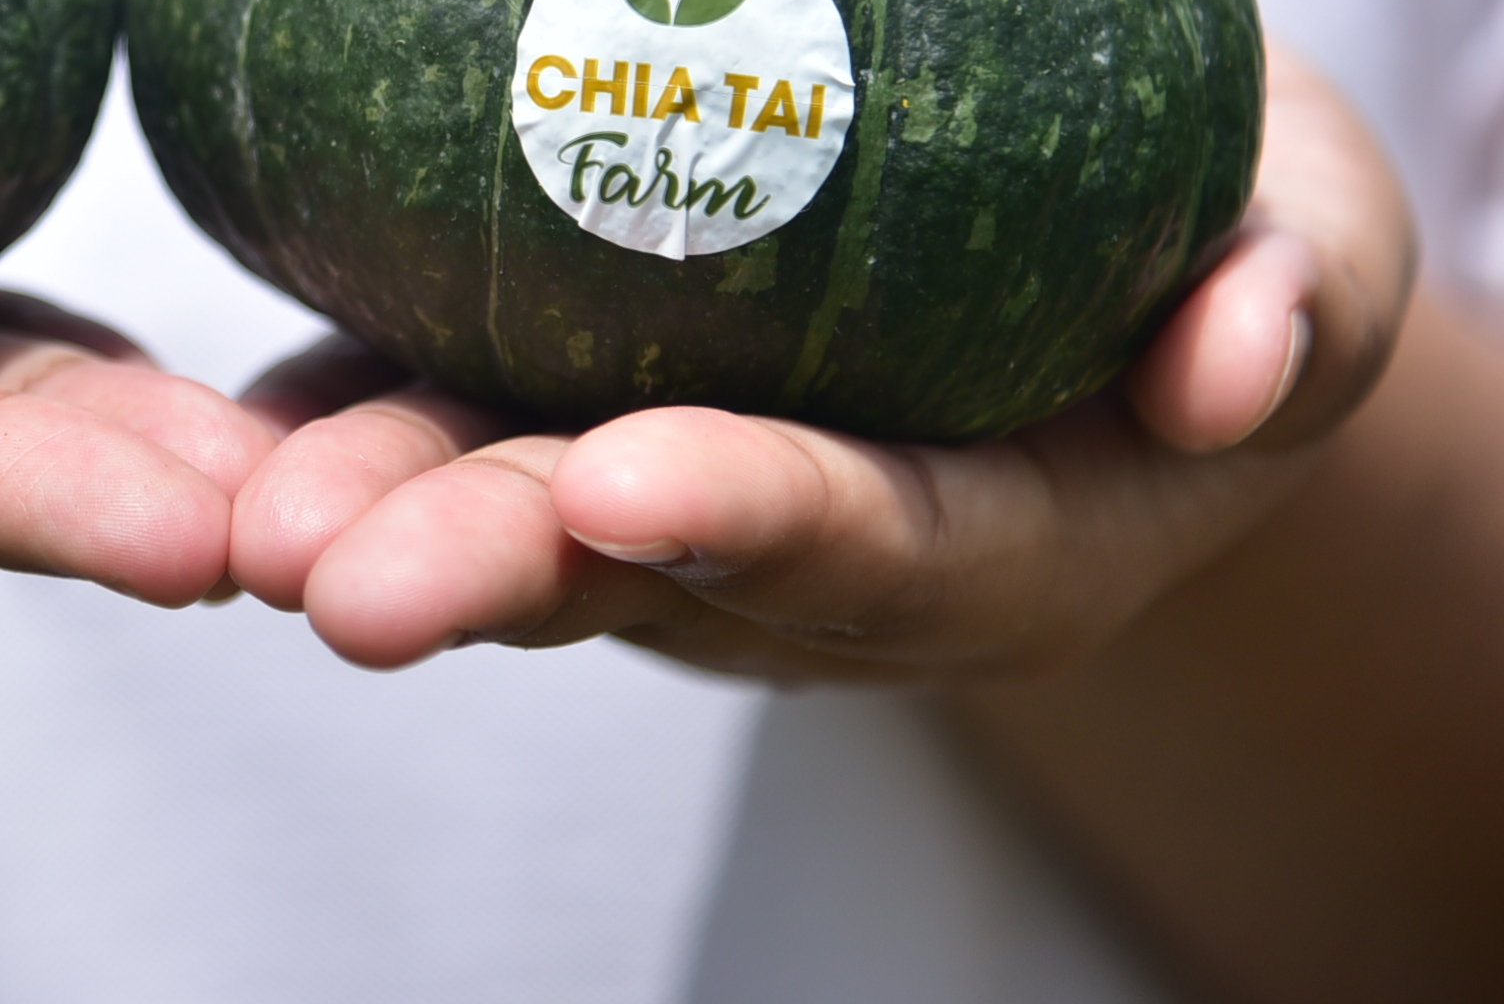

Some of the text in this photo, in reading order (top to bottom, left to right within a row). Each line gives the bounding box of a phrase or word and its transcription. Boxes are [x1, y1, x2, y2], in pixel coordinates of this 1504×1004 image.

[526, 54, 827, 140] CHIA TAI
[557, 131, 771, 221] Farm
